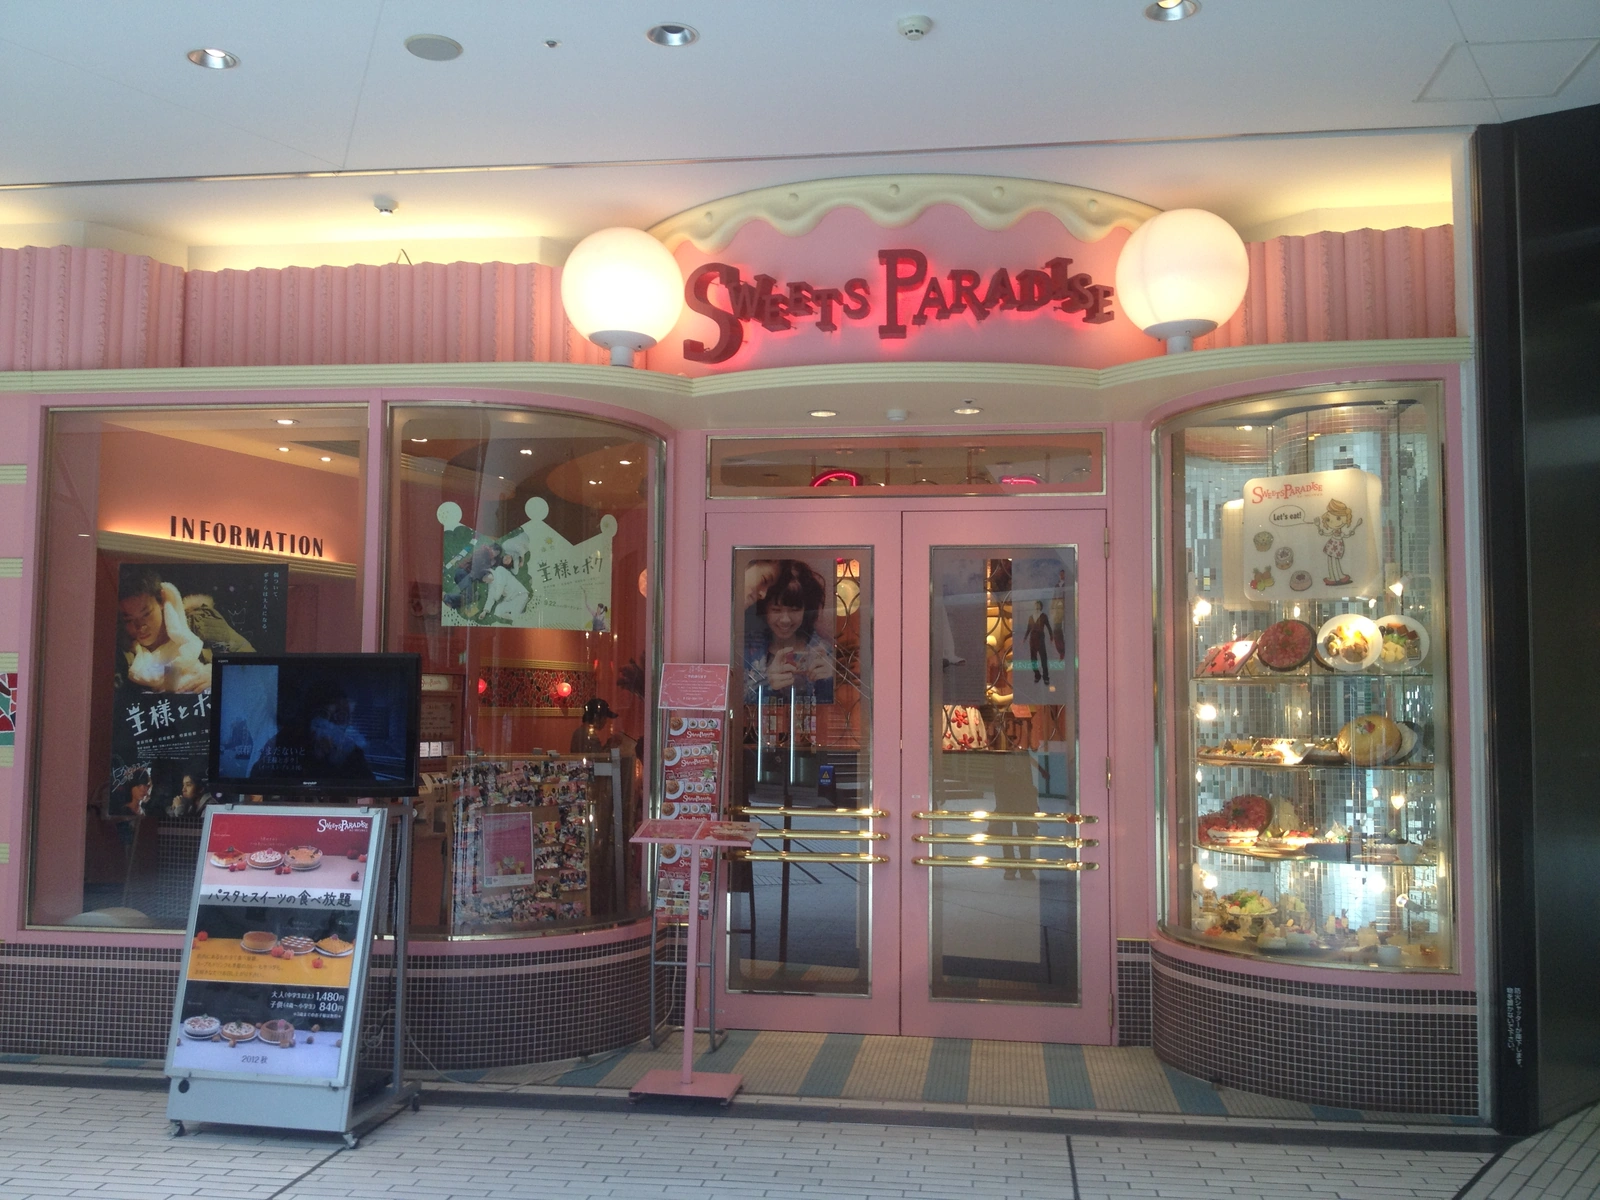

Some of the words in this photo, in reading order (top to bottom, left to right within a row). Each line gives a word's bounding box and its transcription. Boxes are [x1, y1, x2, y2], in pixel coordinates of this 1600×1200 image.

[683, 262, 871, 364] SWEETS
[878, 249, 1115, 339] PARADISE
[1273, 512, 1288, 521] Let's
[1289, 512, 1302, 520] eat!
[170, 515, 325, 558] INFORMATION
[537, 556, 603, 583] 王様とボク
[207, 888, 353, 908] パスタとスイーツの食べ放題
[319, 1002, 344, 1012] 840円
